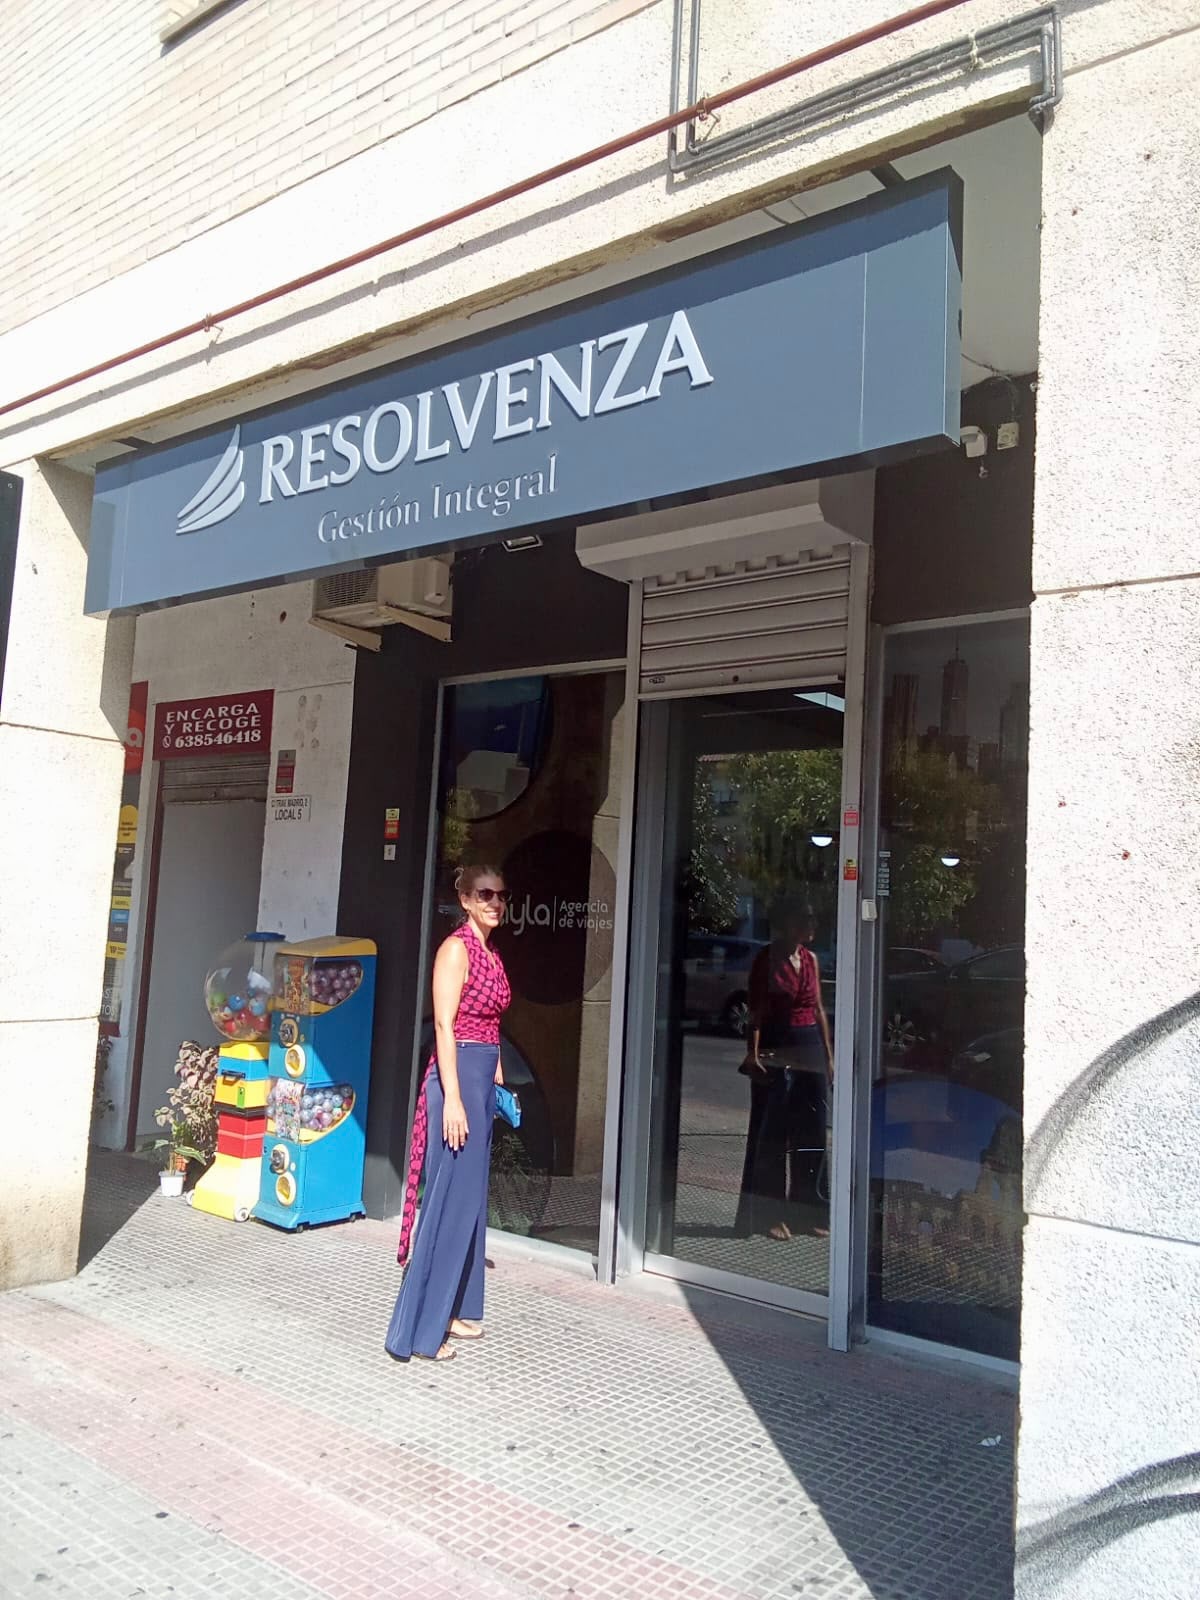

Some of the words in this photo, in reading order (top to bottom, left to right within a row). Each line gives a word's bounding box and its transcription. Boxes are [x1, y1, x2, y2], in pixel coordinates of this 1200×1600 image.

[259, 310, 714, 503] RESOLVENZA
[432, 454, 559, 517] Integral
[166, 702, 259, 723] ENCARGA
[164, 723, 175, 735] Y
[182, 714, 262, 734] RECOGE
[175, 729, 262, 748] 638546418
[275, 808, 296, 820] LOCAL
[297, 808, 302, 820] 5
[560, 899, 608, 917] Agencia
[559, 914, 574, 928] de
[577, 915, 613, 937] viajes
